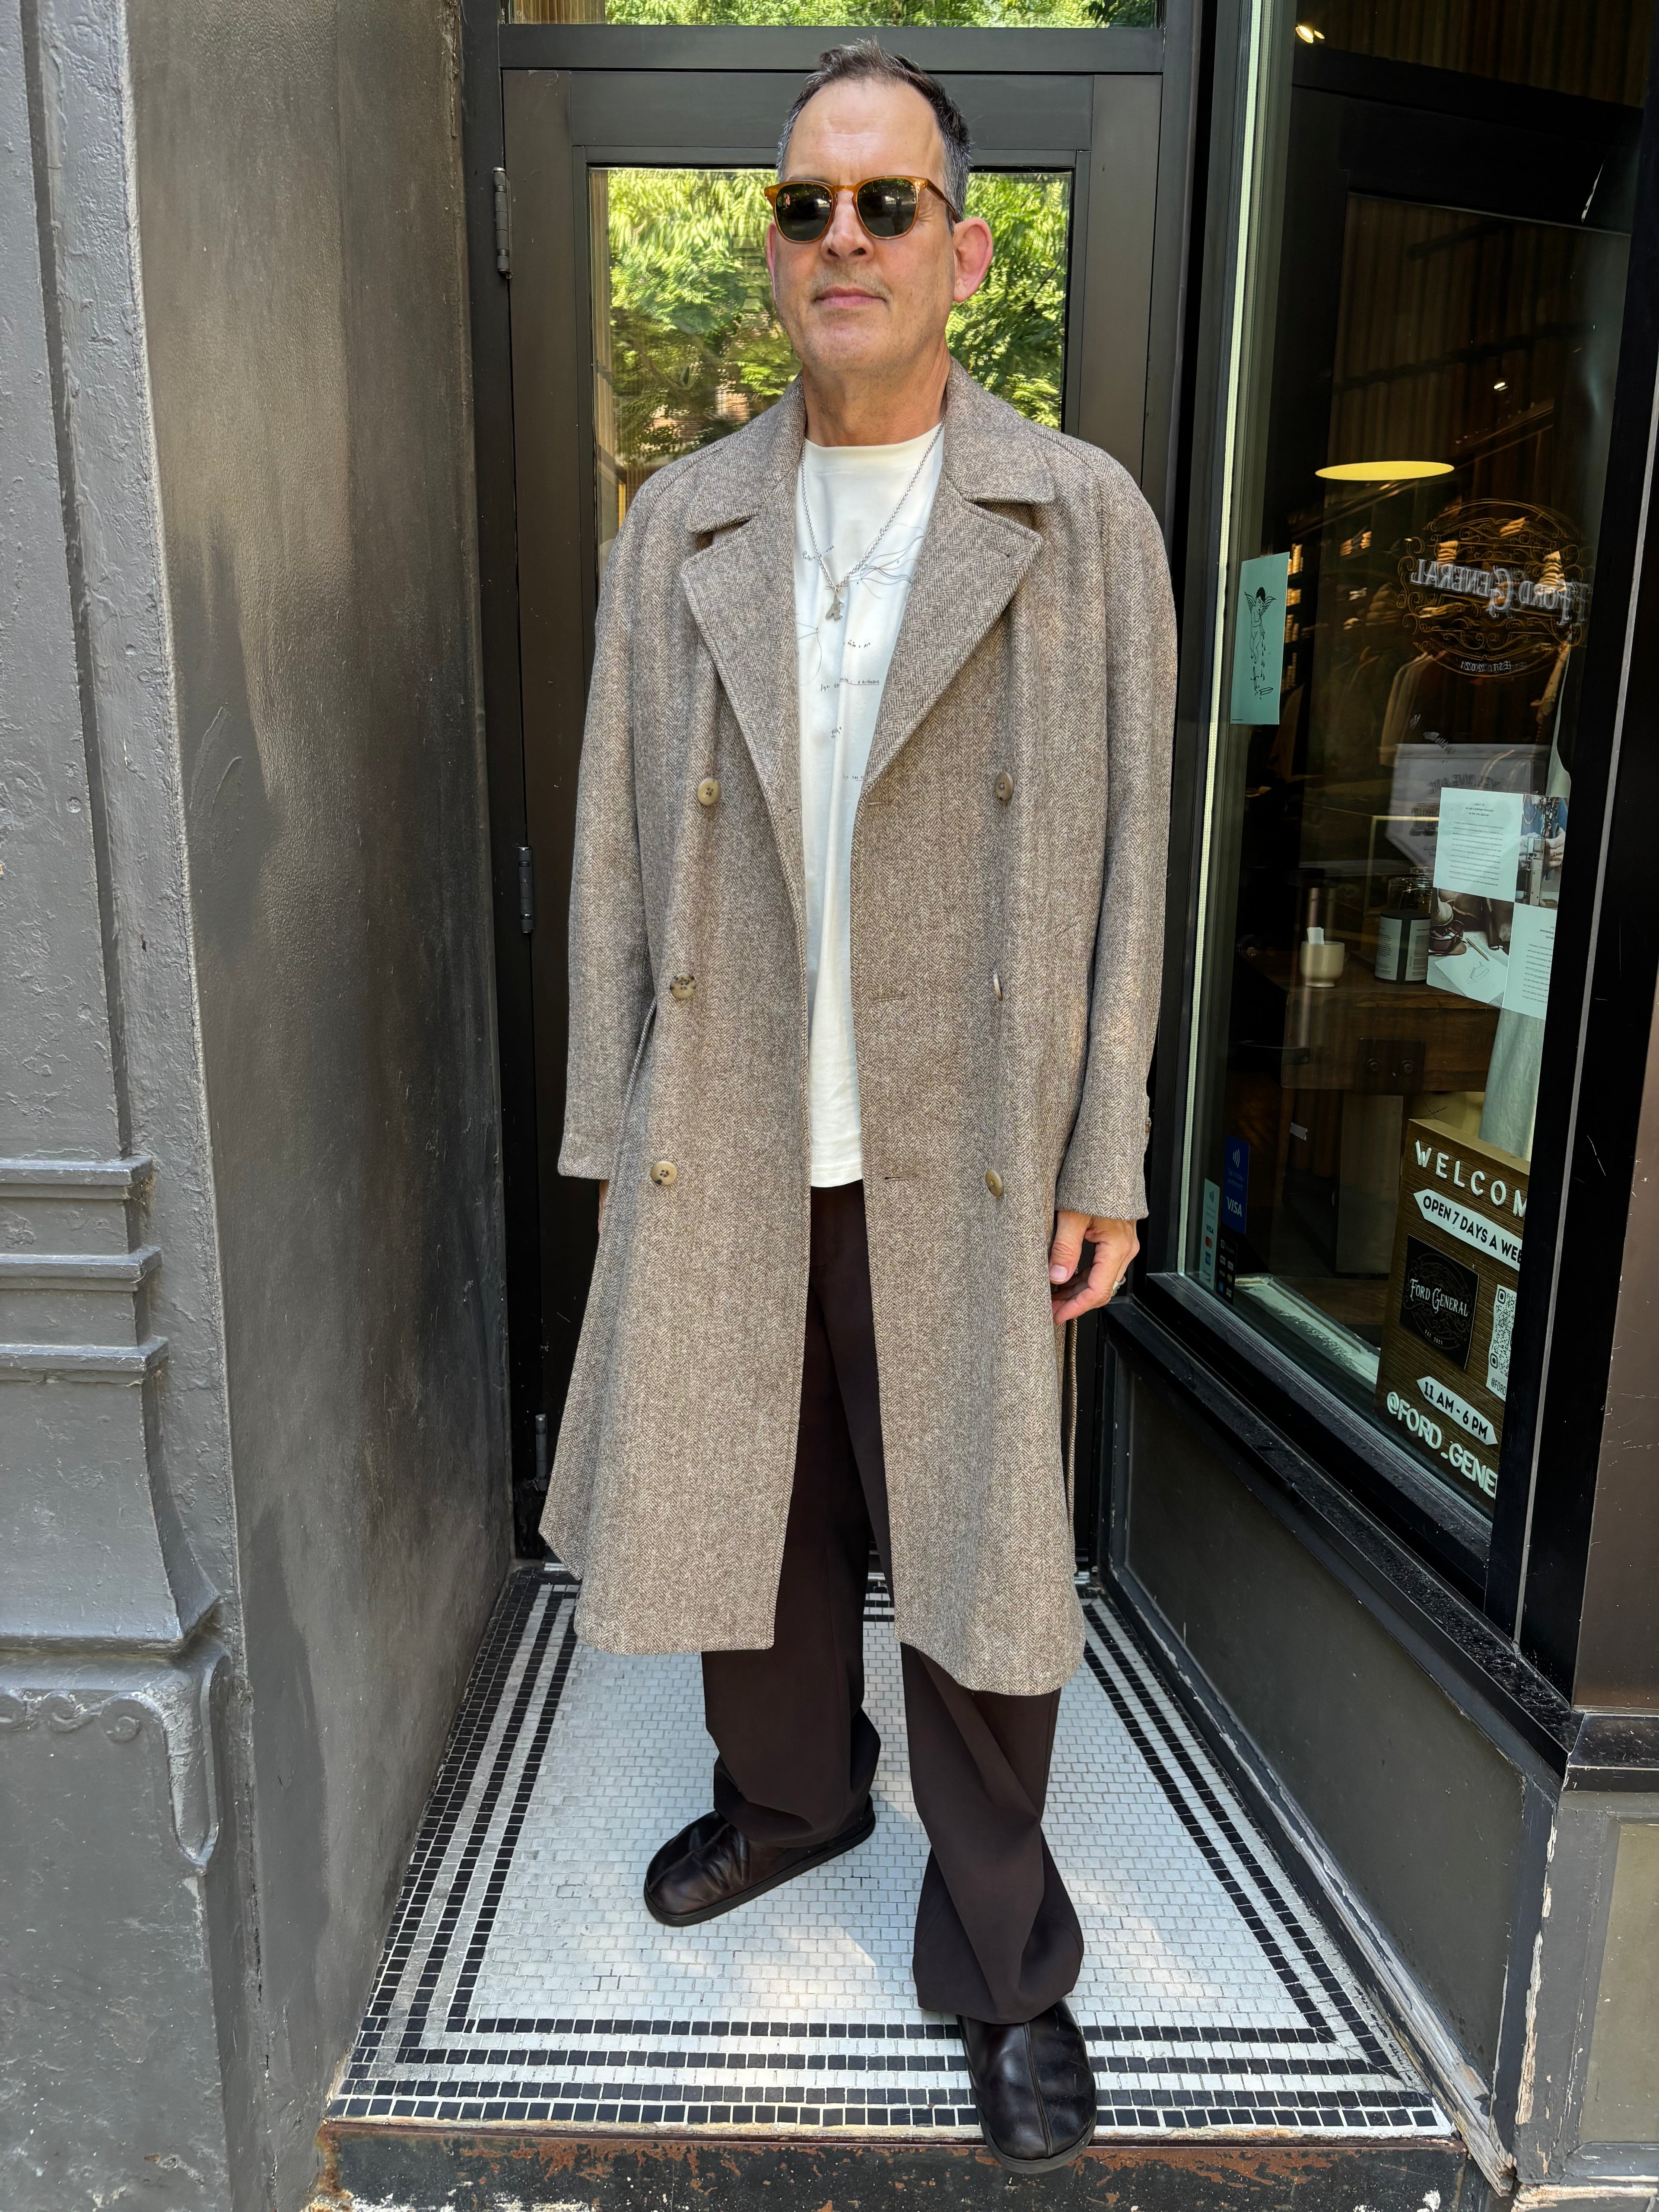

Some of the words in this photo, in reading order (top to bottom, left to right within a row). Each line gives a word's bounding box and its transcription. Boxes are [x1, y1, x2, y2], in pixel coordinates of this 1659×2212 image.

[1227, 1196, 1242, 1217] VISA
[1423, 1195, 1452, 1221] OPEN
[1452, 1211, 1460, 1225] 7
[1460, 1216, 1488, 1243] DAYS
[1489, 1234, 1497, 1250] A
[1410, 1278, 1430, 1301] FORD
[1432, 1288, 1468, 1317] GENERAL
[1424, 1381, 1433, 1400] 11
[1436, 1392, 1454, 1413] AM
[1463, 1411, 1469, 1425] 6
[1472, 1416, 1488, 1440] PM
